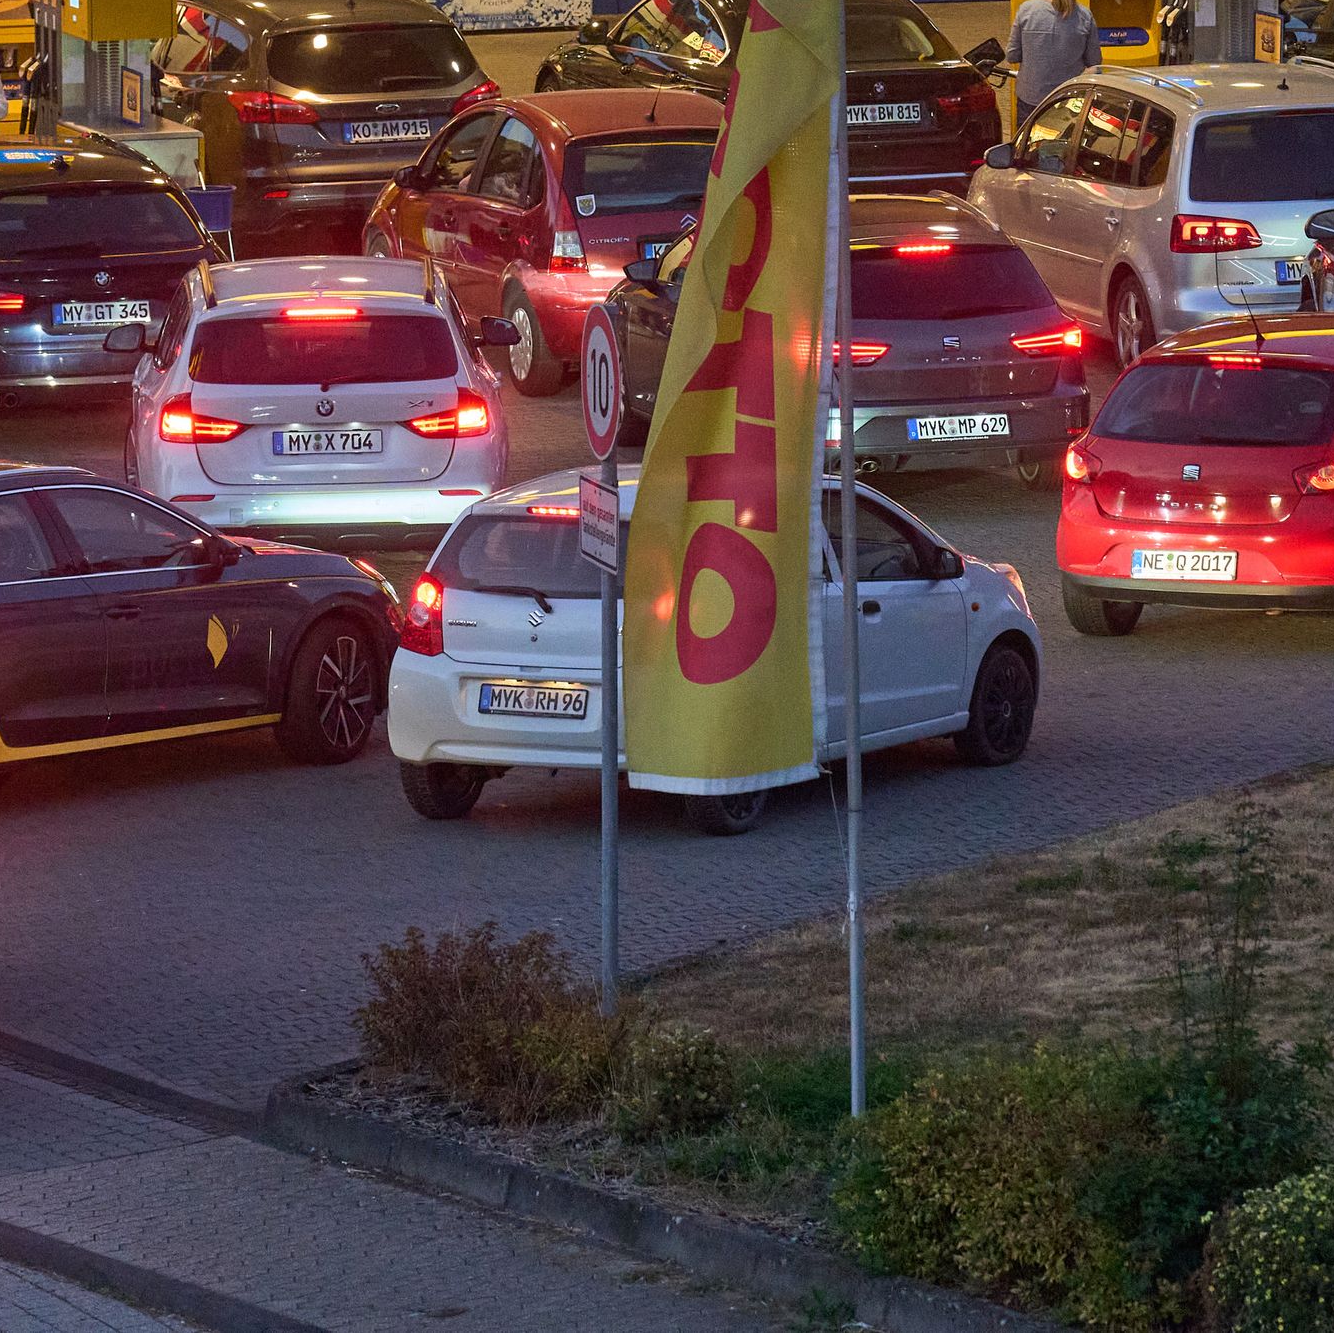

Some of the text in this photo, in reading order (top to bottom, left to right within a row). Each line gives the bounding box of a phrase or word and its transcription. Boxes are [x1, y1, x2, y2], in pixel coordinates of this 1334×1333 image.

[878, 106, 894, 121] BW
[897, 105, 919, 119] 815
[352, 121, 429, 139] KO AM 915
[63, 303, 148, 322] MY GT 345
[590, 348, 609, 418] 10
[918, 417, 1007, 436] MYK MP 629
[288, 432, 373, 451] MY X 704
[1143, 554, 1233, 572] NE Q 2017
[490, 688, 583, 712] MYK RH 96
